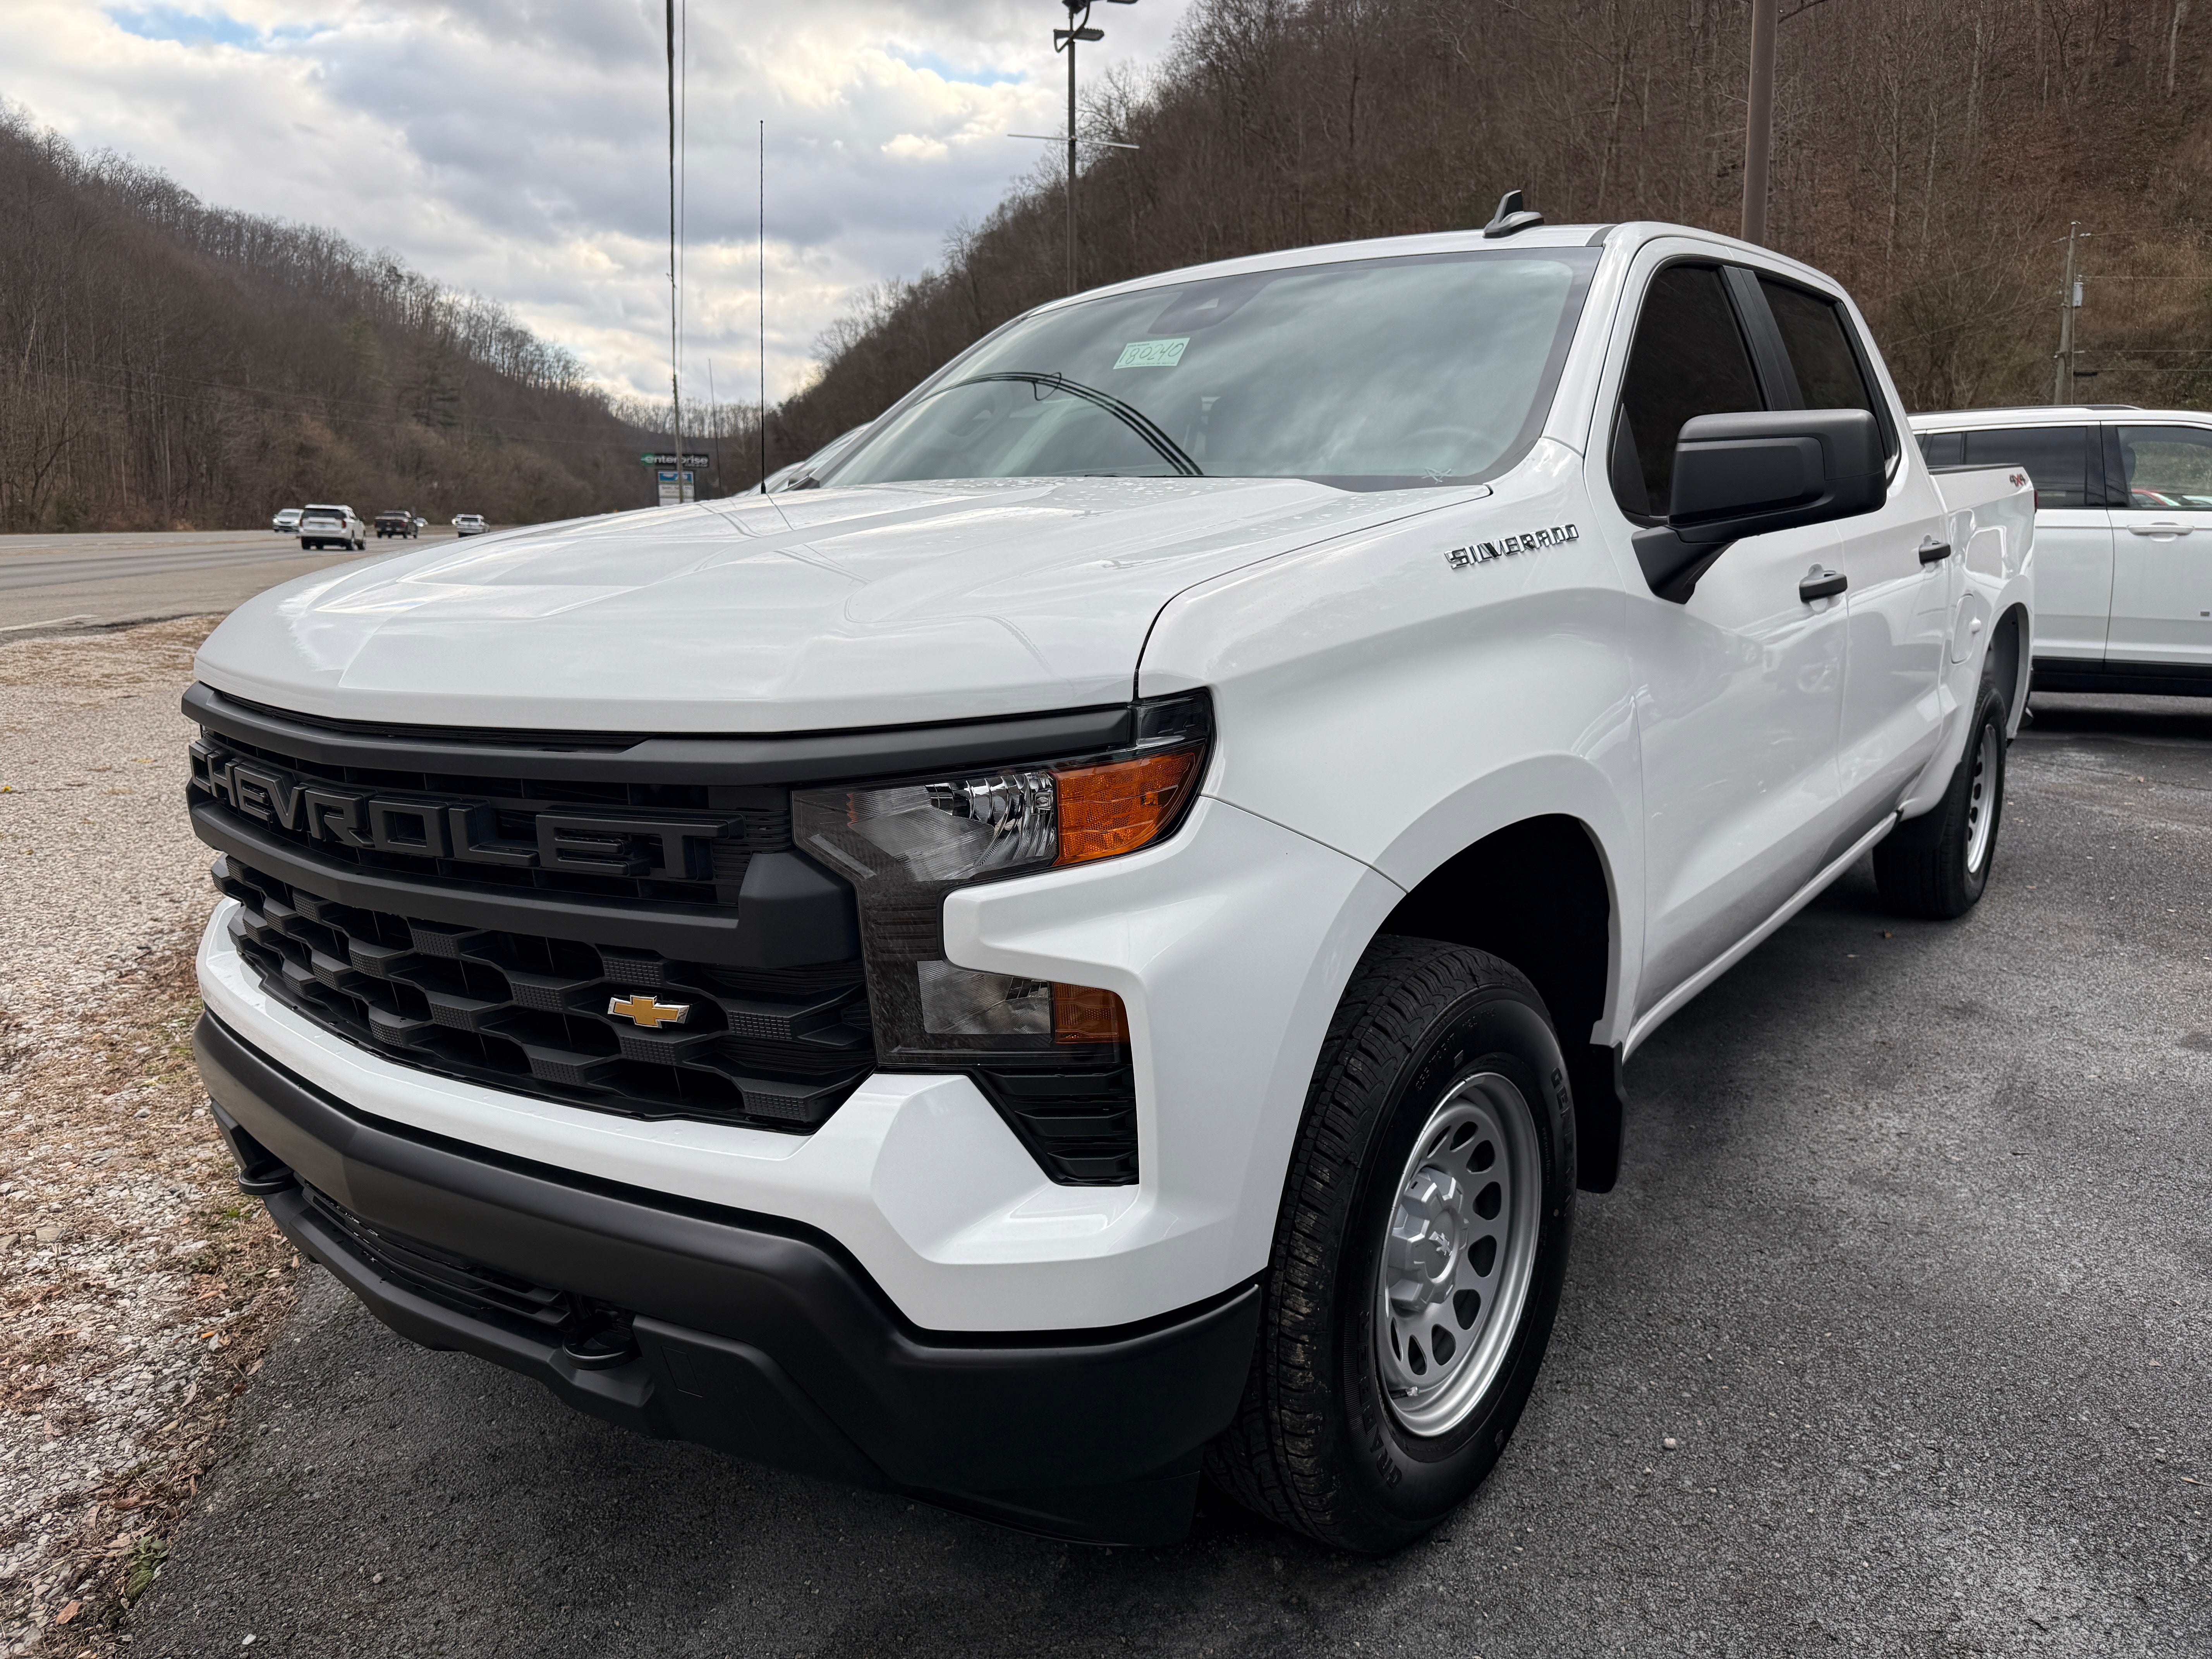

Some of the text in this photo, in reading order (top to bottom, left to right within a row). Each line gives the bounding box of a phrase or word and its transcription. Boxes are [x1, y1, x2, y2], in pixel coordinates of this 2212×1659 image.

[1119, 342, 1184, 364] 180240
[1444, 524, 1580, 570] SILVERADO
[188, 738, 745, 881] CHEVROLET
[1357, 1310, 1402, 1490] GRABBER
